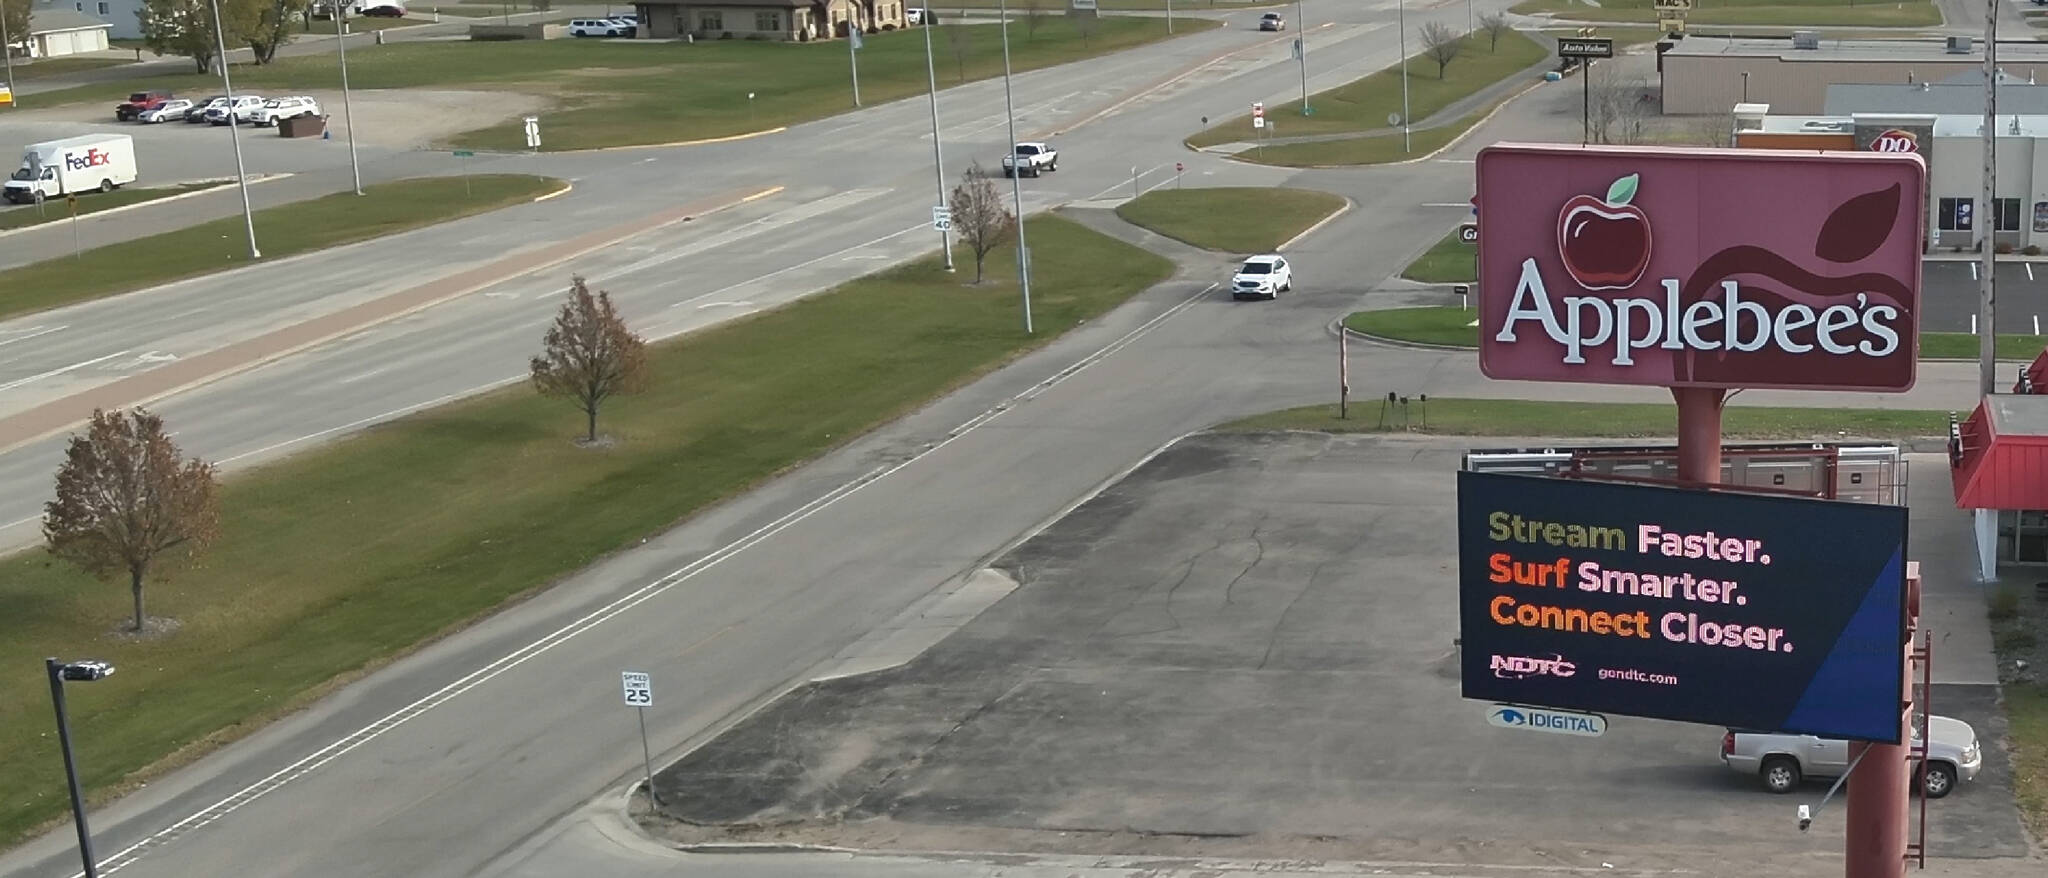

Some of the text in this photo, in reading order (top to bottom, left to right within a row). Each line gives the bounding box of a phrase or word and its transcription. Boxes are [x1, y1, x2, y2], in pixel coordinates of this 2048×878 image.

[1562, 43, 1607, 52] Auto Value
[1880, 137, 1911, 152] DQ
[65, 148, 110, 171] FedEx
[936, 221, 950, 229] 40
[1496, 257, 1899, 366] Applebee's
[1489, 511, 1771, 565] Stream Faster.
[1489, 552, 1747, 606] Surf Smarter.
[1490, 595, 1794, 653] Connect Closer.
[1489, 654, 1678, 686] NDTC gondtc.com
[626, 689, 650, 703] 25
